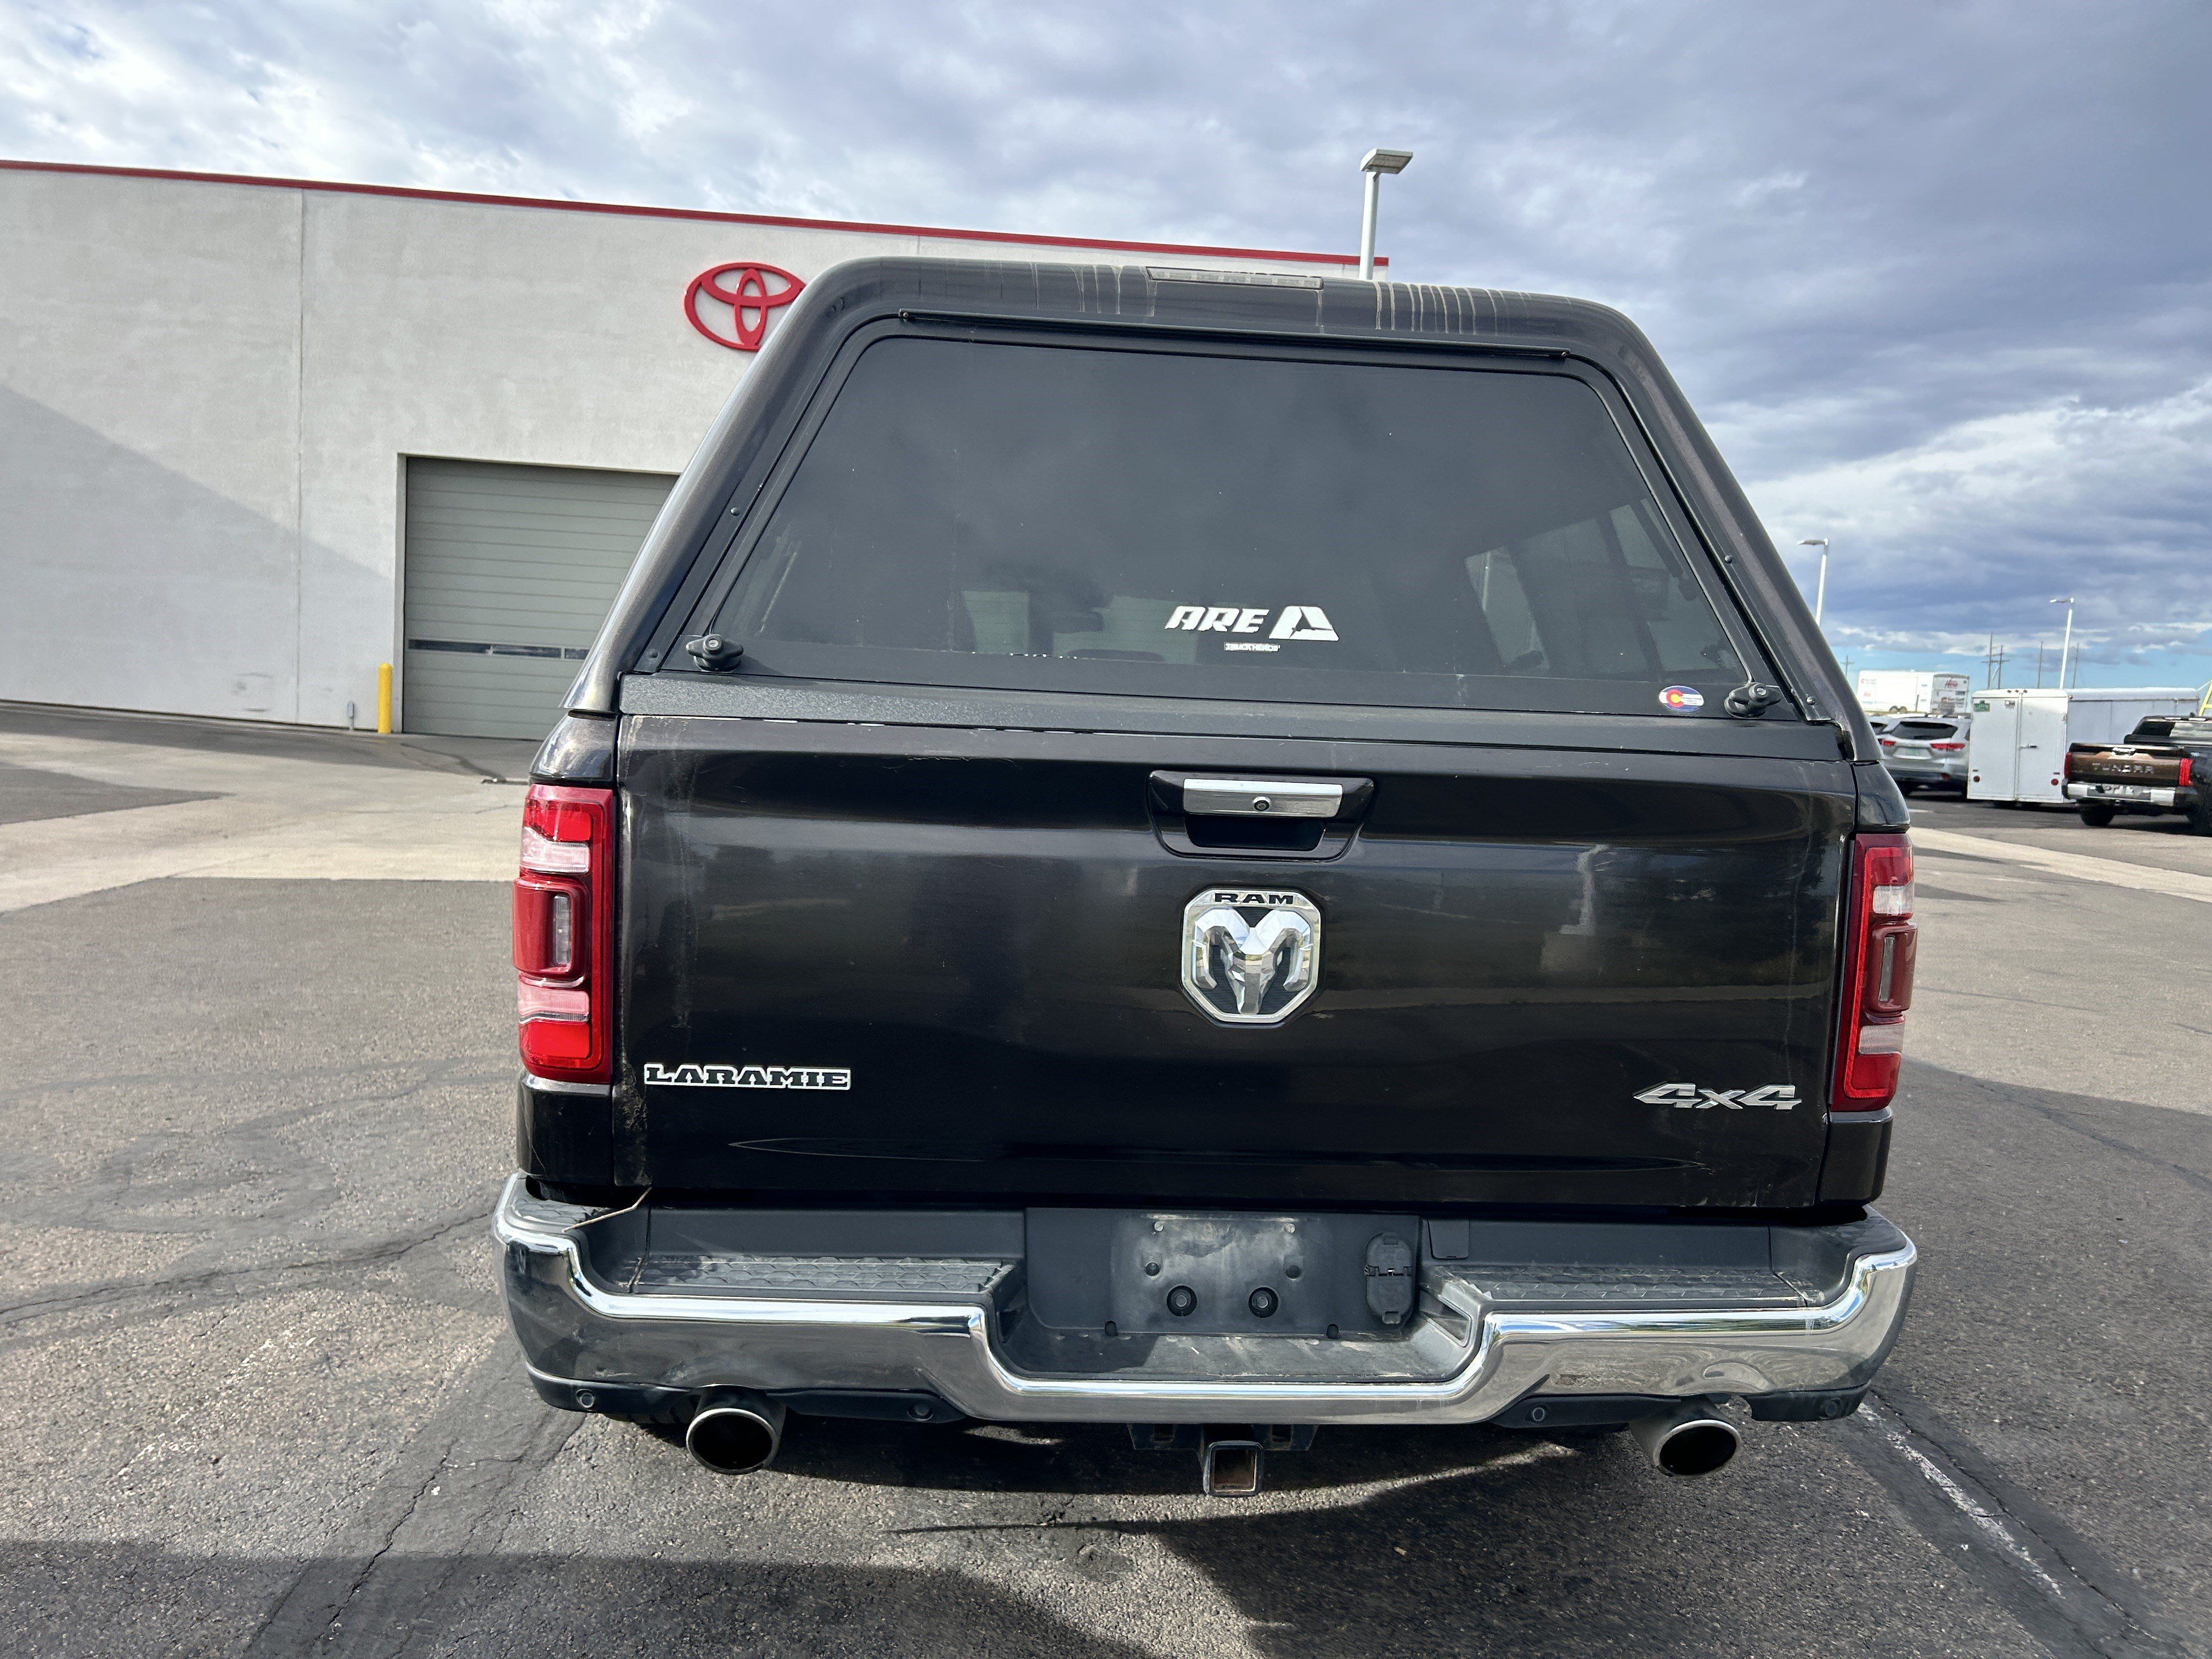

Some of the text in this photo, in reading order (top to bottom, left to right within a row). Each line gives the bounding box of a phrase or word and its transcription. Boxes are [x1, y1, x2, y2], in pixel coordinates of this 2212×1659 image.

[1165, 606, 1269, 633] ARE
[2092, 763, 2154, 774] TUNDRA
[1215, 893, 1294, 905] RAM
[644, 1063, 851, 1090] LARAMIE
